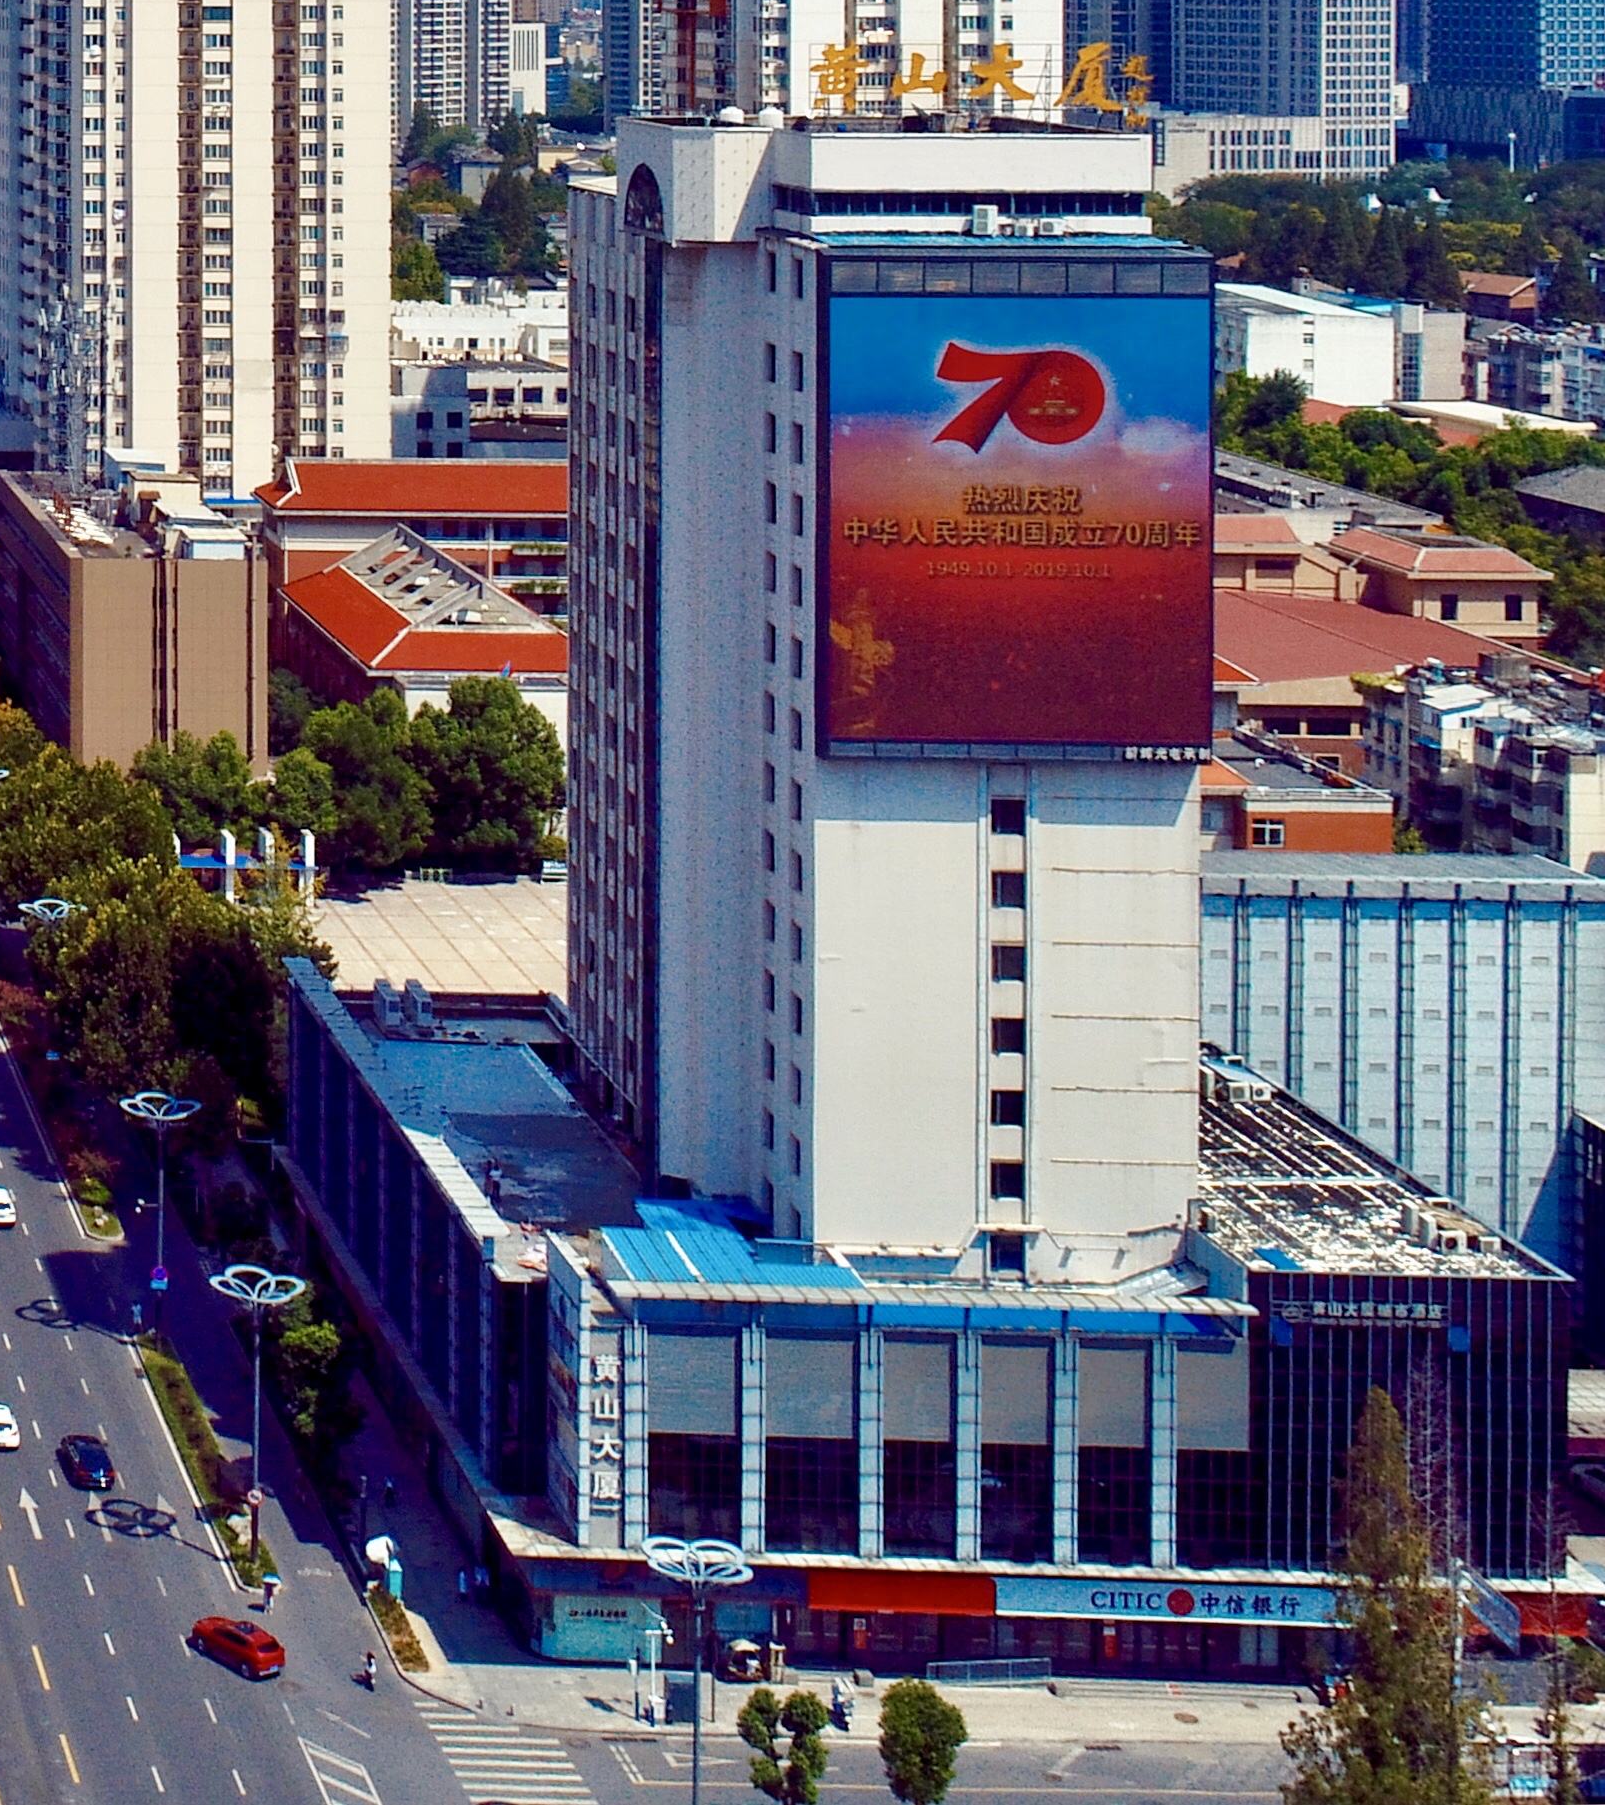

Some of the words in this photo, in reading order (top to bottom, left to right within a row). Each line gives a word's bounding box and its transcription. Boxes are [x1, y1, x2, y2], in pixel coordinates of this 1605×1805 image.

[809, 42, 1124, 114] 黄山大厦
[931, 341, 1106, 454] 70
[963, 483, 1082, 515] 热烈庆祝
[843, 516, 1202, 548] 中华人民共和国成立70周年
[591, 1354, 622, 1514] 黄山大厦
[1090, 1589, 1162, 1610] CITIC
[1200, 1592, 1301, 1617] 中信银行
